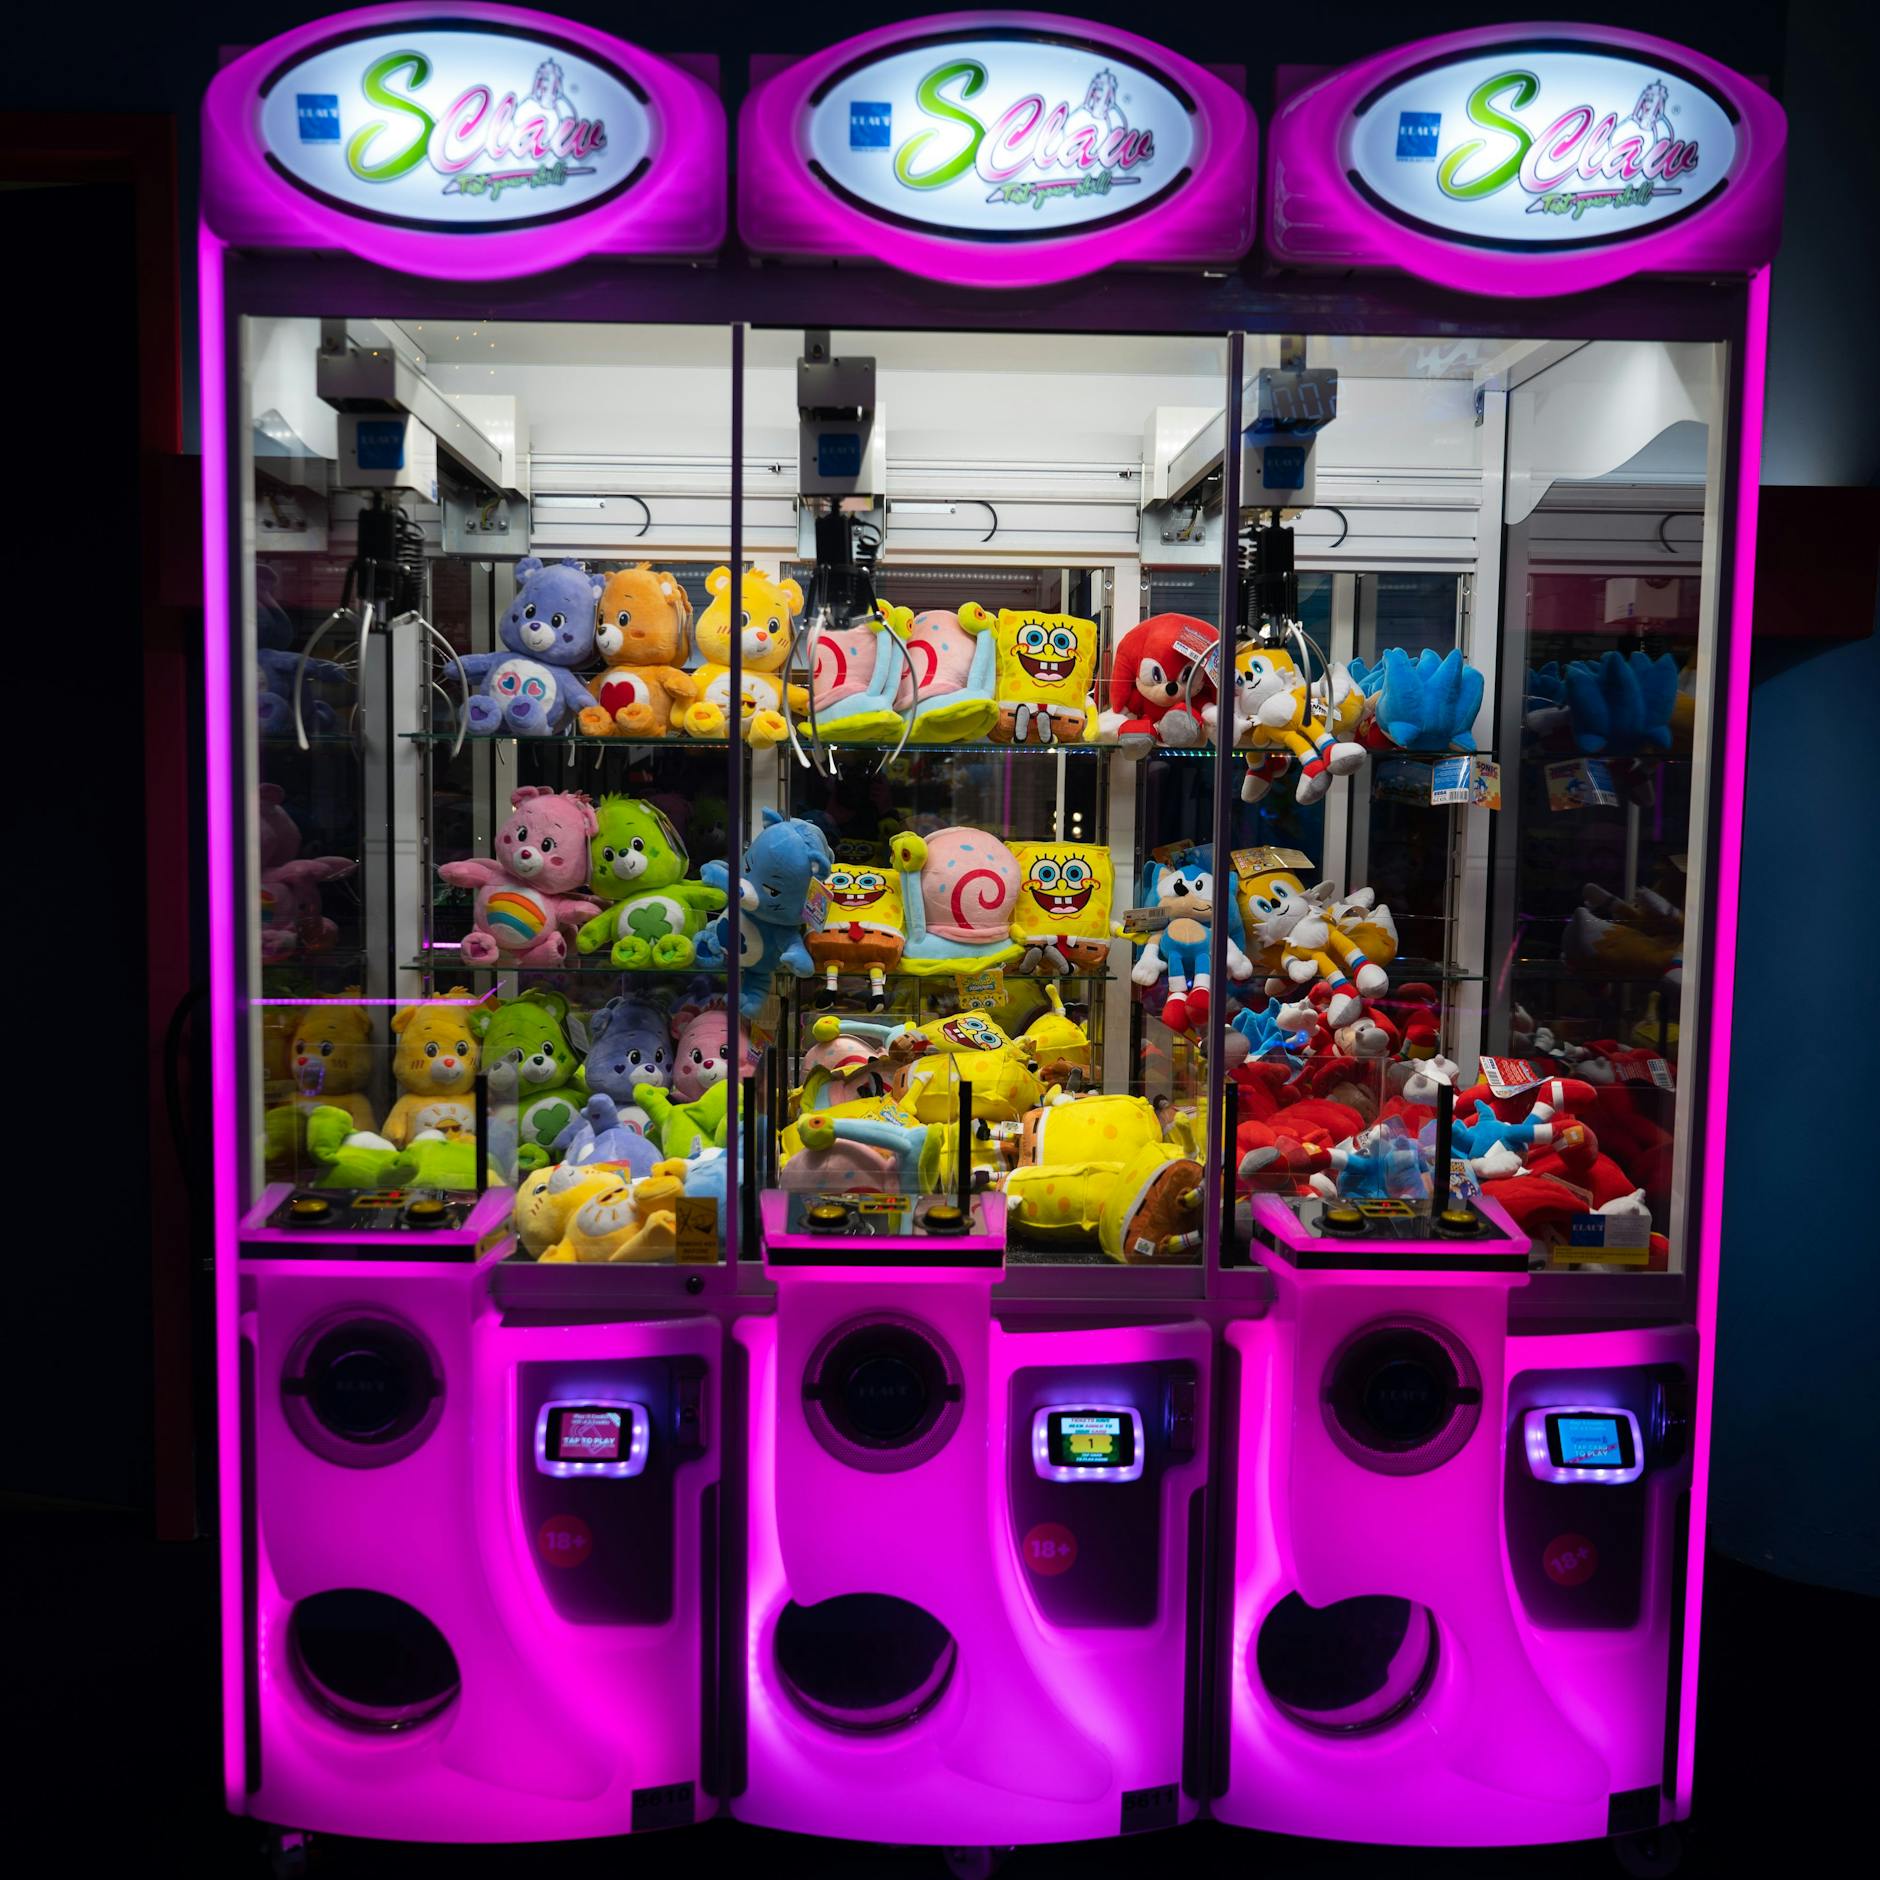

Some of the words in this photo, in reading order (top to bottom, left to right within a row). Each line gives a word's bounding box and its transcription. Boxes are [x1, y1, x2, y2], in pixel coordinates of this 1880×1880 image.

[1088, 1439, 1093, 1449] 1
[546, 1531, 586, 1552] 18+
[1032, 1540, 1070, 1558] 18+
[1552, 1546, 1589, 1574] 18+
